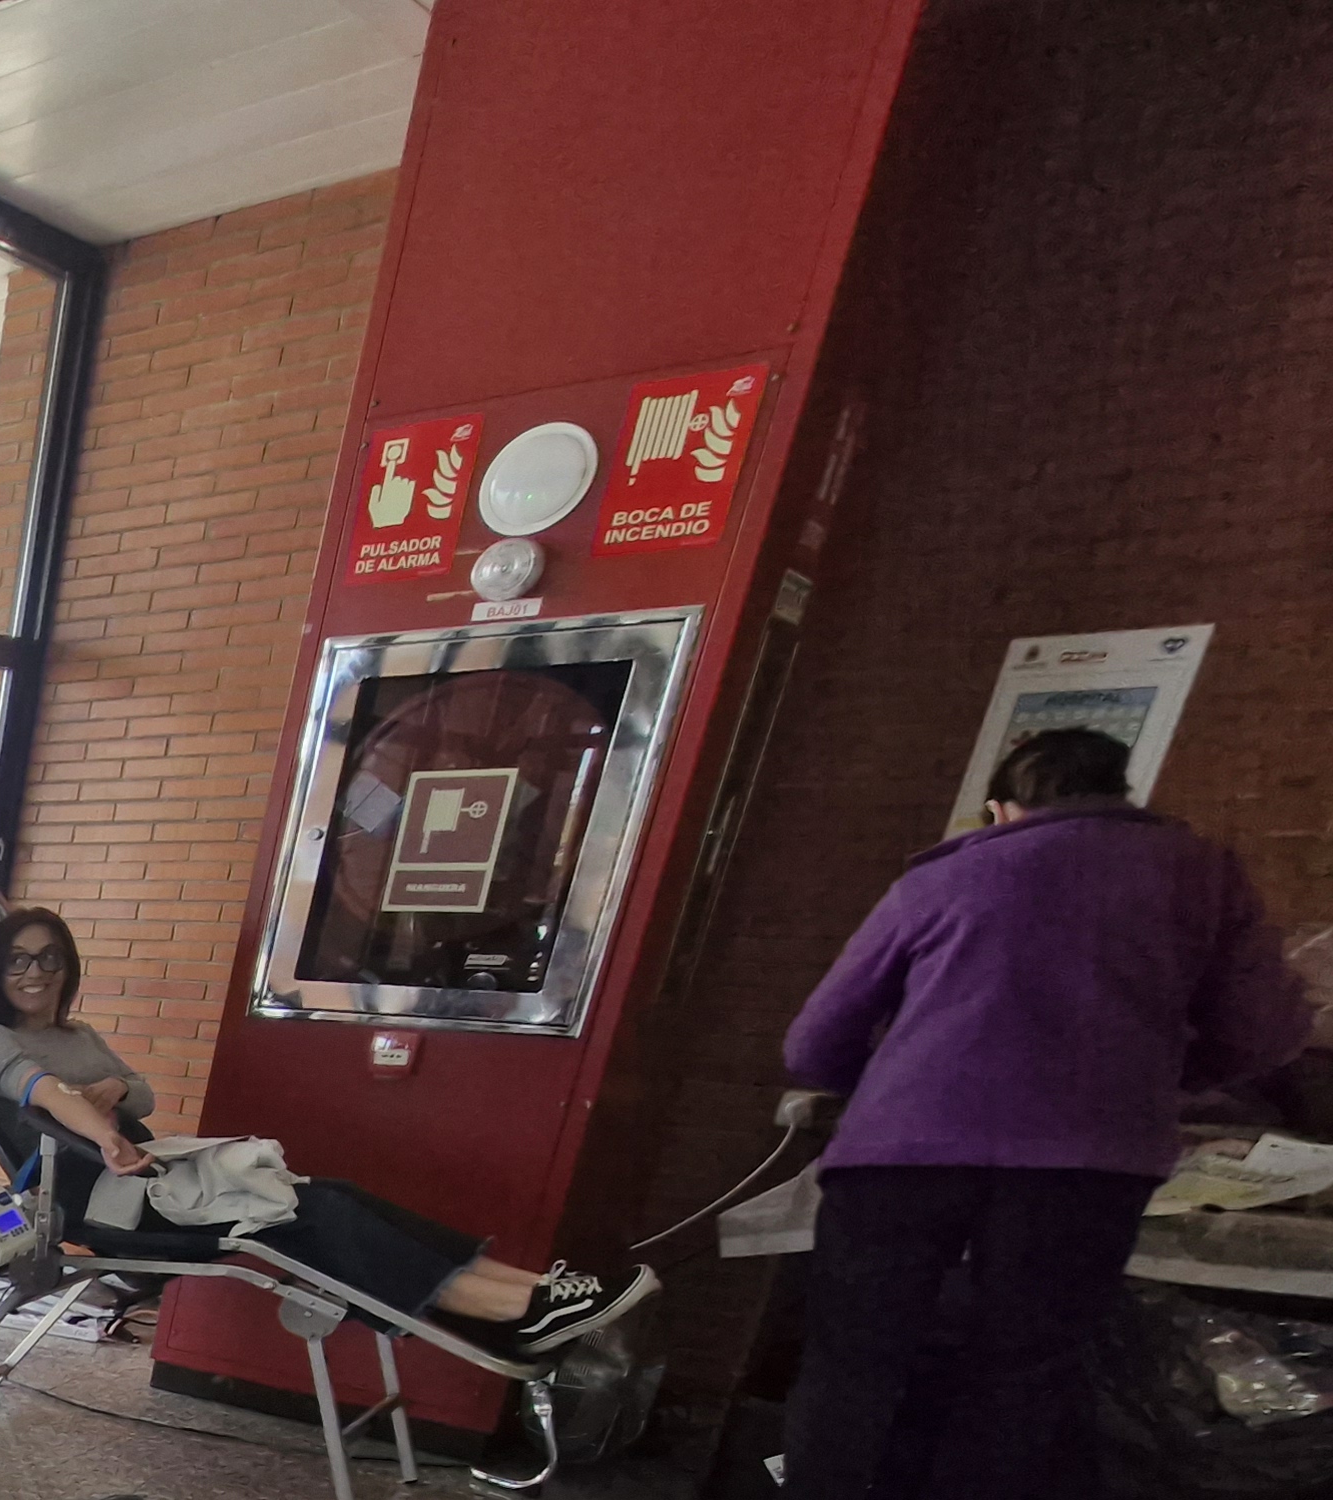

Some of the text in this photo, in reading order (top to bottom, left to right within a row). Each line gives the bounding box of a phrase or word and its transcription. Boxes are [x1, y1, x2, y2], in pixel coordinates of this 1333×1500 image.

[611, 500, 713, 527] BOCA DE
[603, 518, 711, 545] INCENDIO
[360, 535, 442, 558] PULSADOR
[354, 551, 441, 574] DE ALARMA
